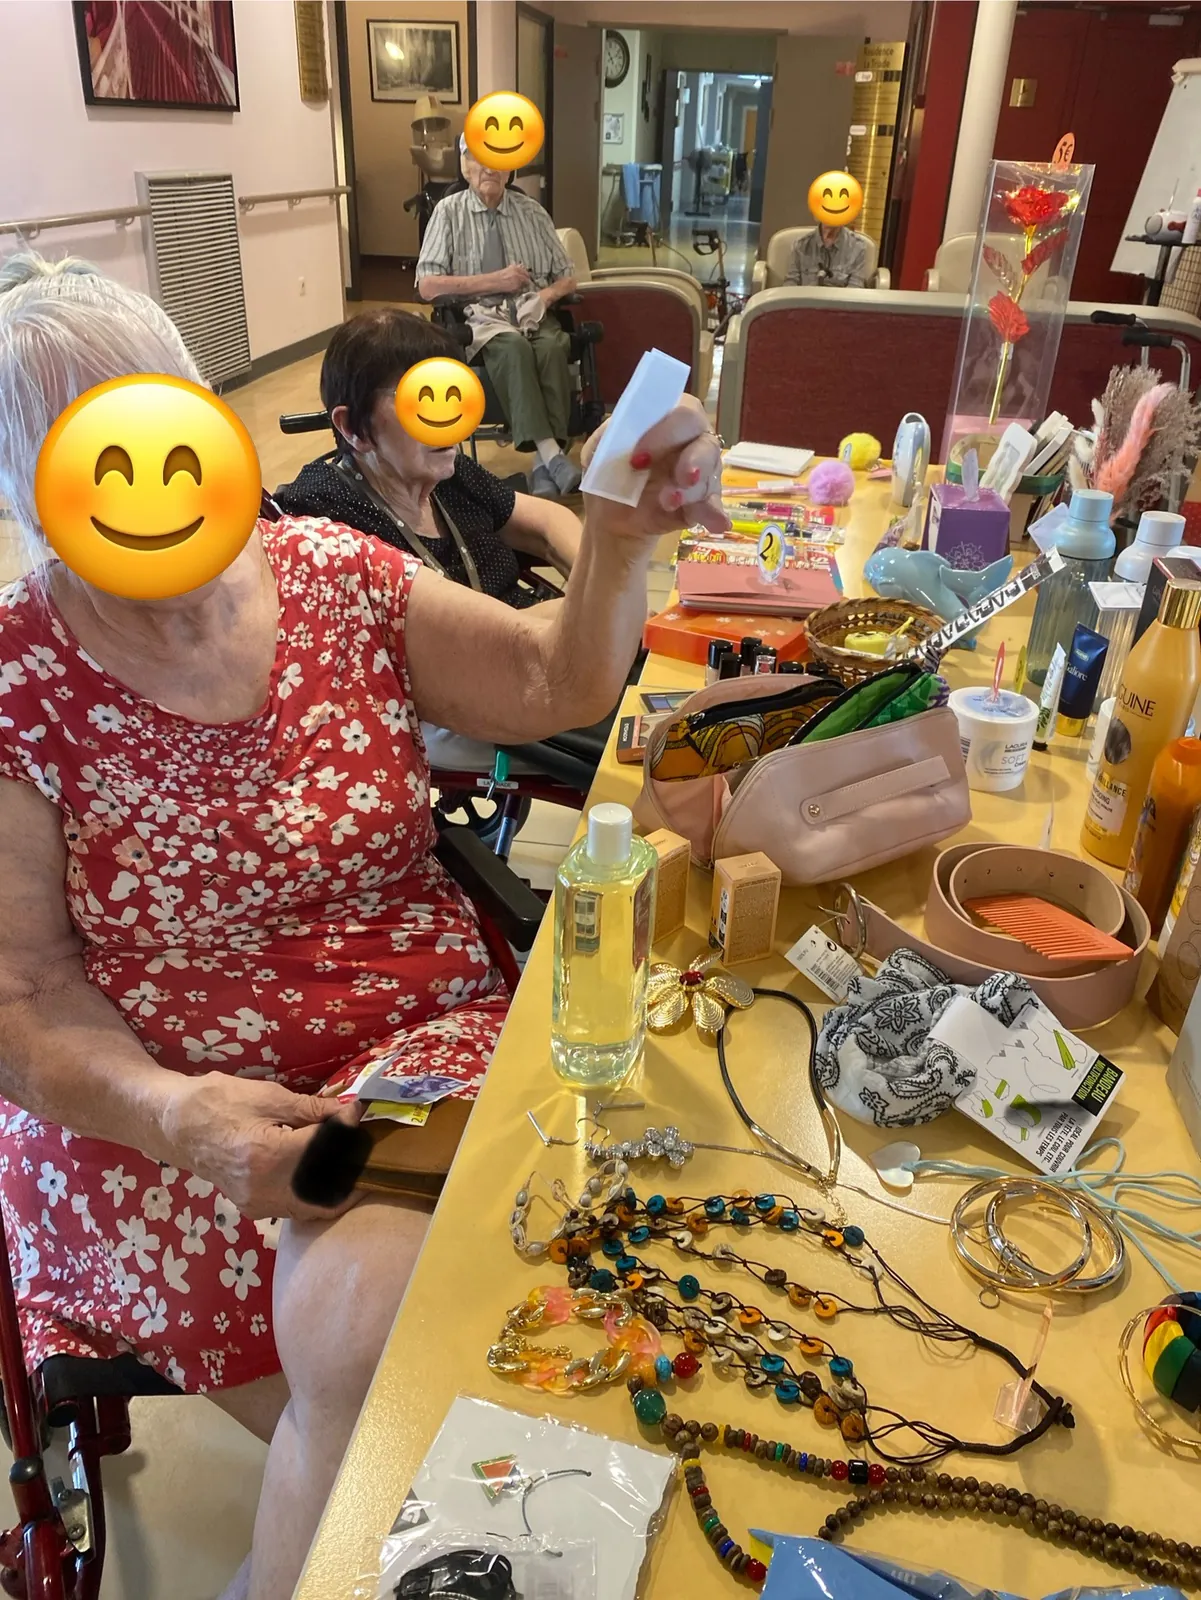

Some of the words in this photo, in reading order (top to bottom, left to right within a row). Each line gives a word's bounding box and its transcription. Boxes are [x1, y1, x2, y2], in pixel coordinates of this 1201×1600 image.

[1053, 141, 1073, 163] 5€
[1001, 753, 1026, 765] SOFT
[1075, 1059, 1106, 1101] MULTIFONCTION
[1091, 1067, 1119, 1104] BANDEAU
[1058, 1111, 1069, 1123] PAR
[1068, 1117, 1076, 1126] LA
[1050, 1120, 1063, 1134] TOUS
[1045, 1131, 1056, 1142] LES
[1056, 1135, 1065, 1144] LE
[1035, 1140, 1050, 1157] TEMPS
[1062, 1139, 1075, 1153] POUR
[1049, 1152, 1066, 1173] COUVRIR
